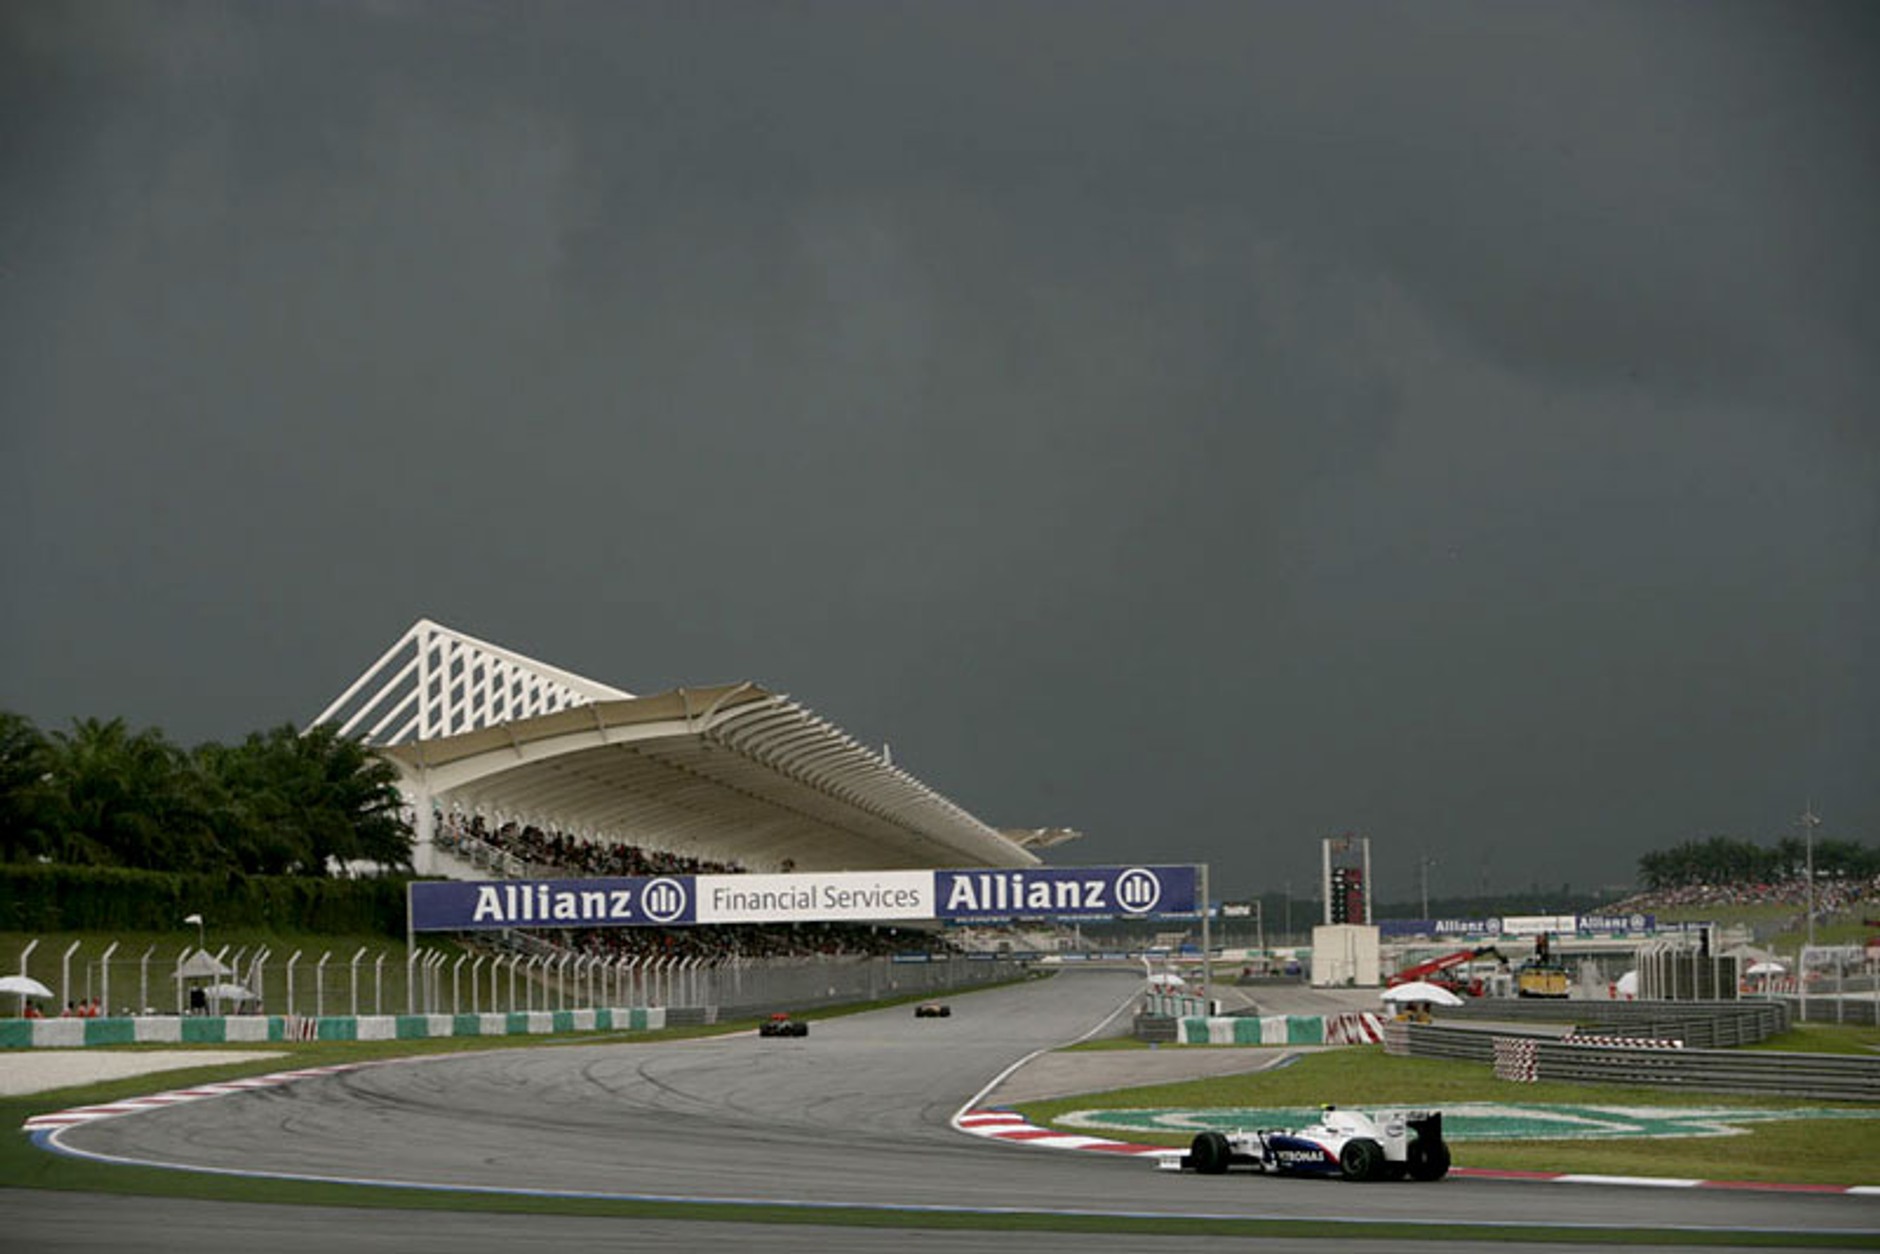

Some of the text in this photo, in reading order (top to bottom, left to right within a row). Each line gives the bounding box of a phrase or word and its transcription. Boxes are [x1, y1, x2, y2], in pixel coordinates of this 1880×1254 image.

[473, 884, 632, 922] Allianz
[713, 884, 920, 911] Financial Services
[947, 873, 1106, 911] Allianz
[1435, 920, 1485, 932] Allianz
[1579, 917, 1628, 929] Allianz
